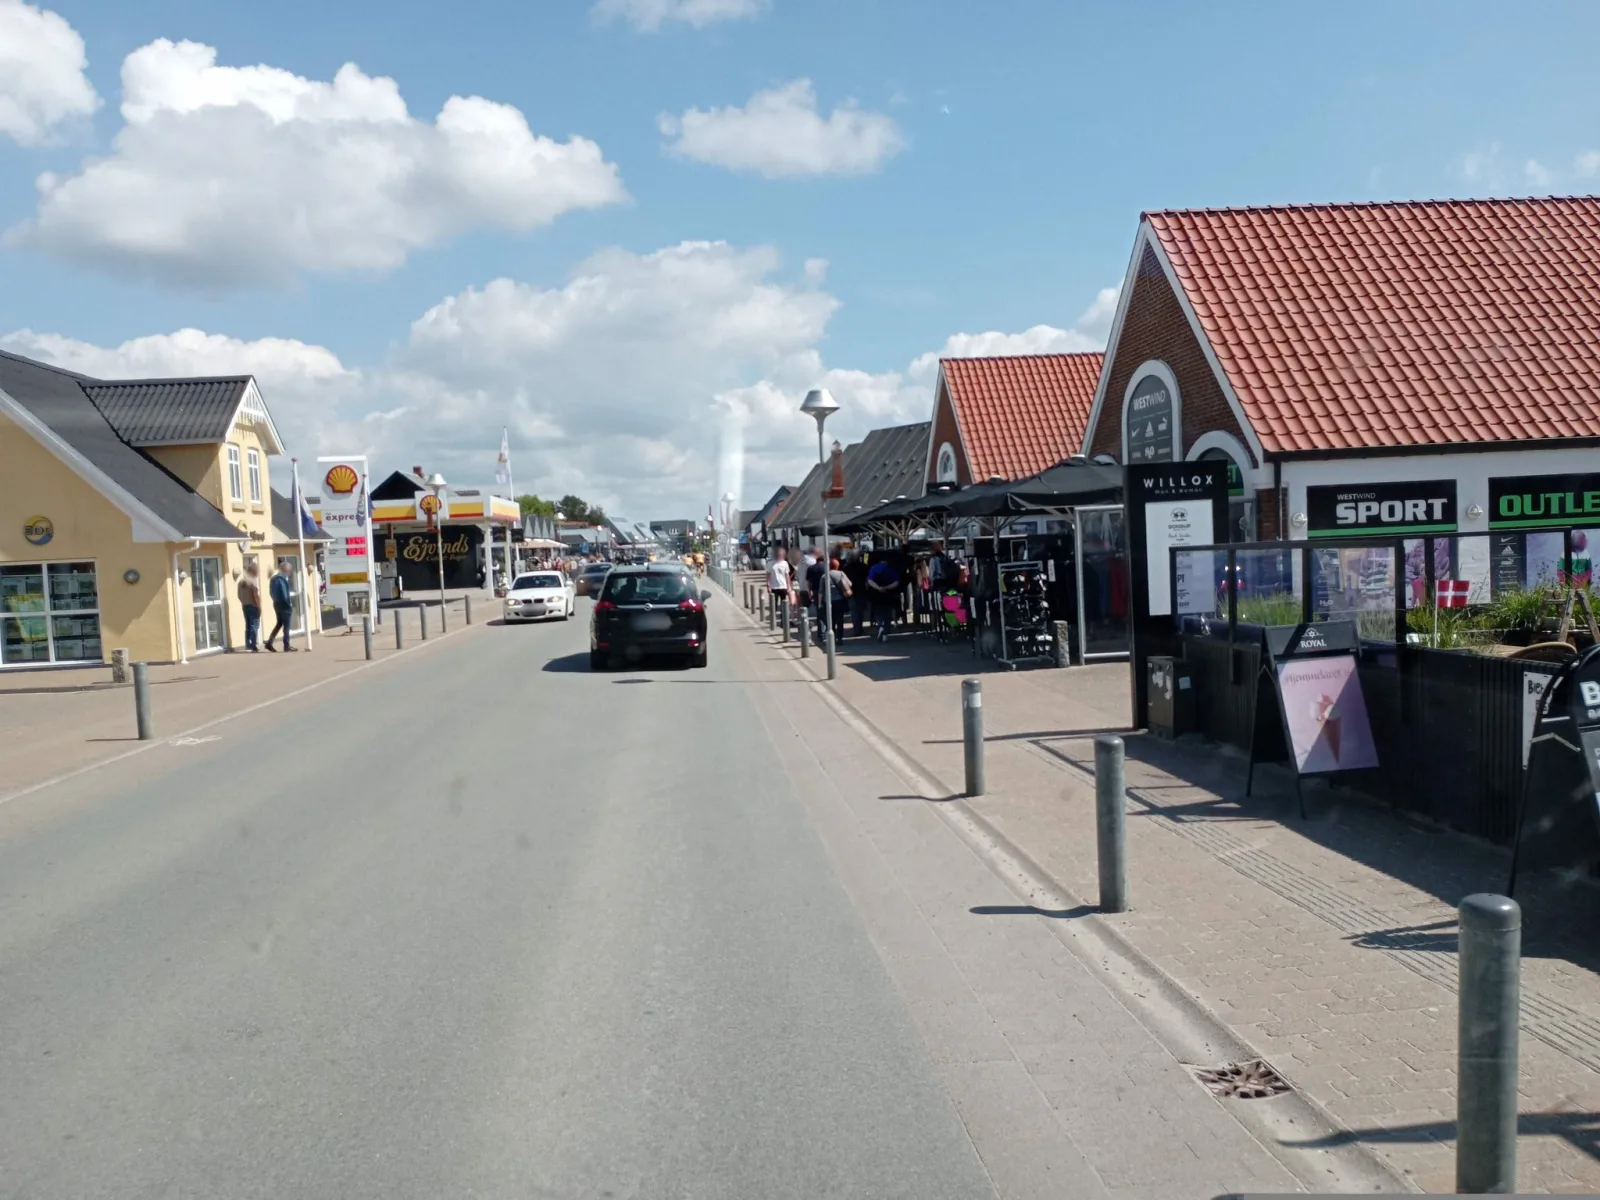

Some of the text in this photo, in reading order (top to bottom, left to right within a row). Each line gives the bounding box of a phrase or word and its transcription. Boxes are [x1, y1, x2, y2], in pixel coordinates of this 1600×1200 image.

[1133, 390, 1166, 411] WESTWIND
[1143, 476, 1212, 488] WILLOX
[1336, 498, 1448, 525] SPORT
[403, 533, 469, 562] Ejvnds
[1300, 639, 1327, 648] ROYAL
